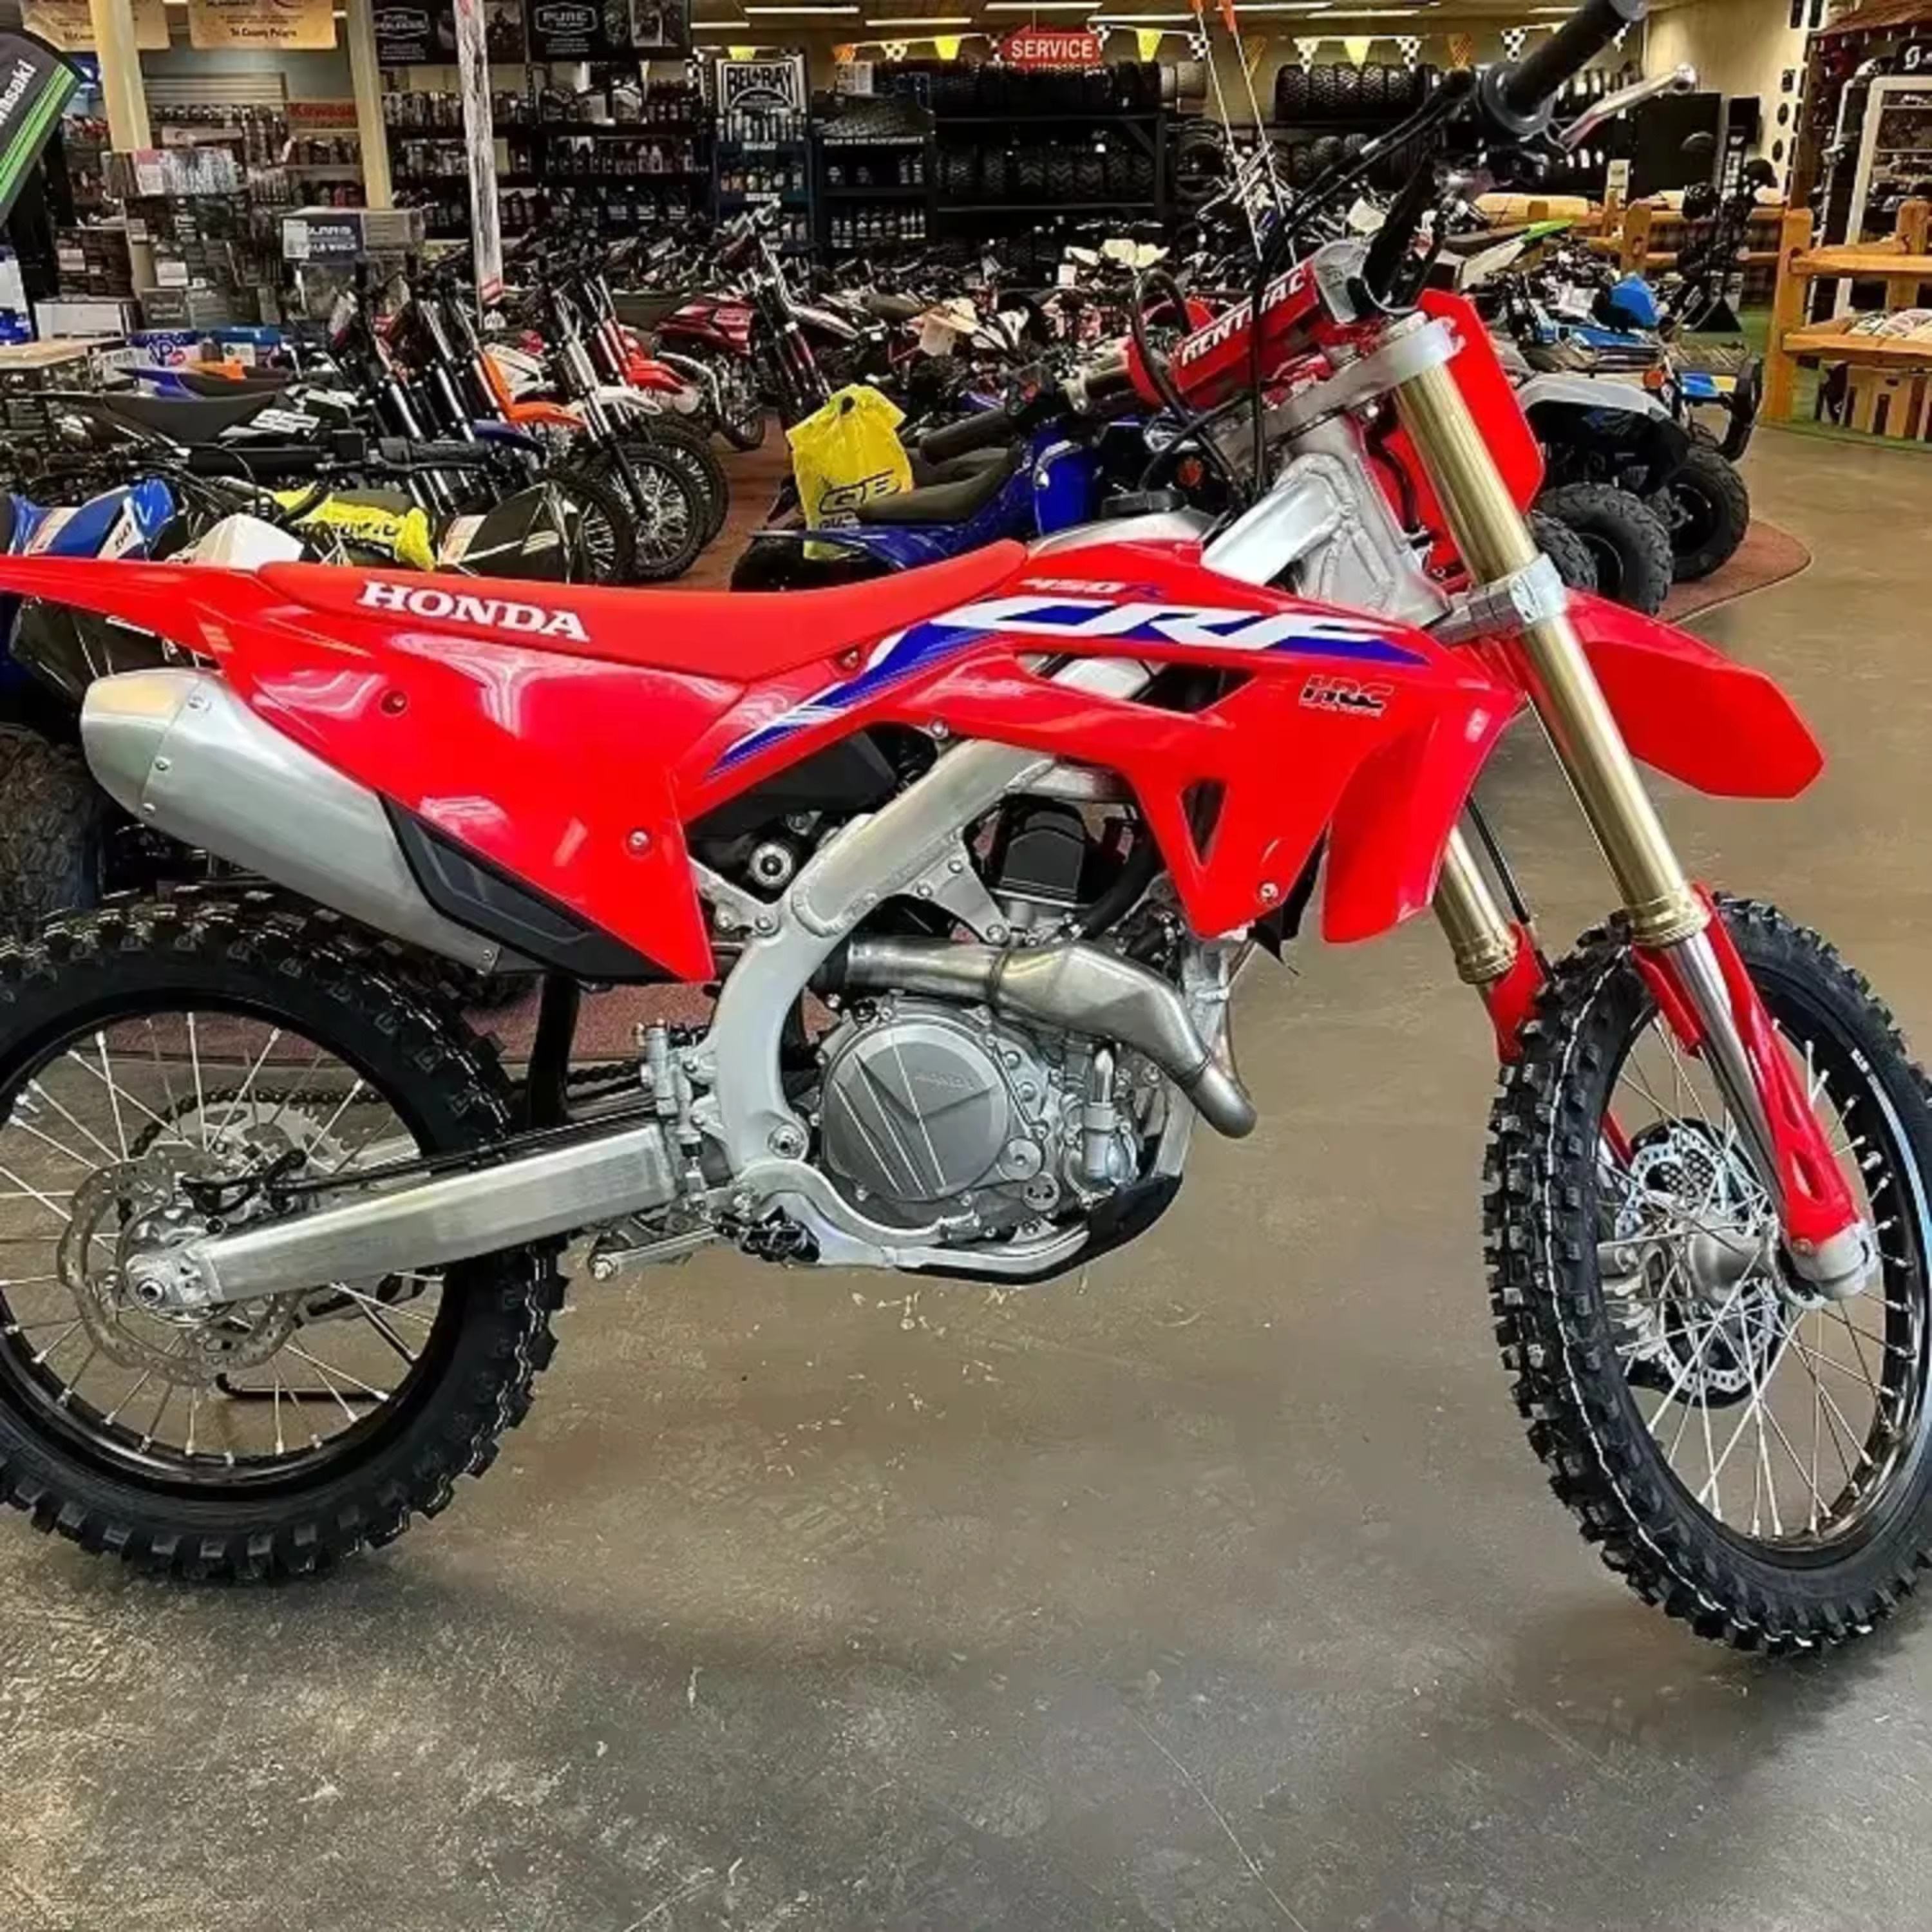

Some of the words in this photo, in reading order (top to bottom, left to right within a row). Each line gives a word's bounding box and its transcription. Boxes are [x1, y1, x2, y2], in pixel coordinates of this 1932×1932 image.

[1011, 38, 1094, 59] SERVICE
[355, 580, 591, 643] HONDA
[929, 595, 1406, 650] CRF
